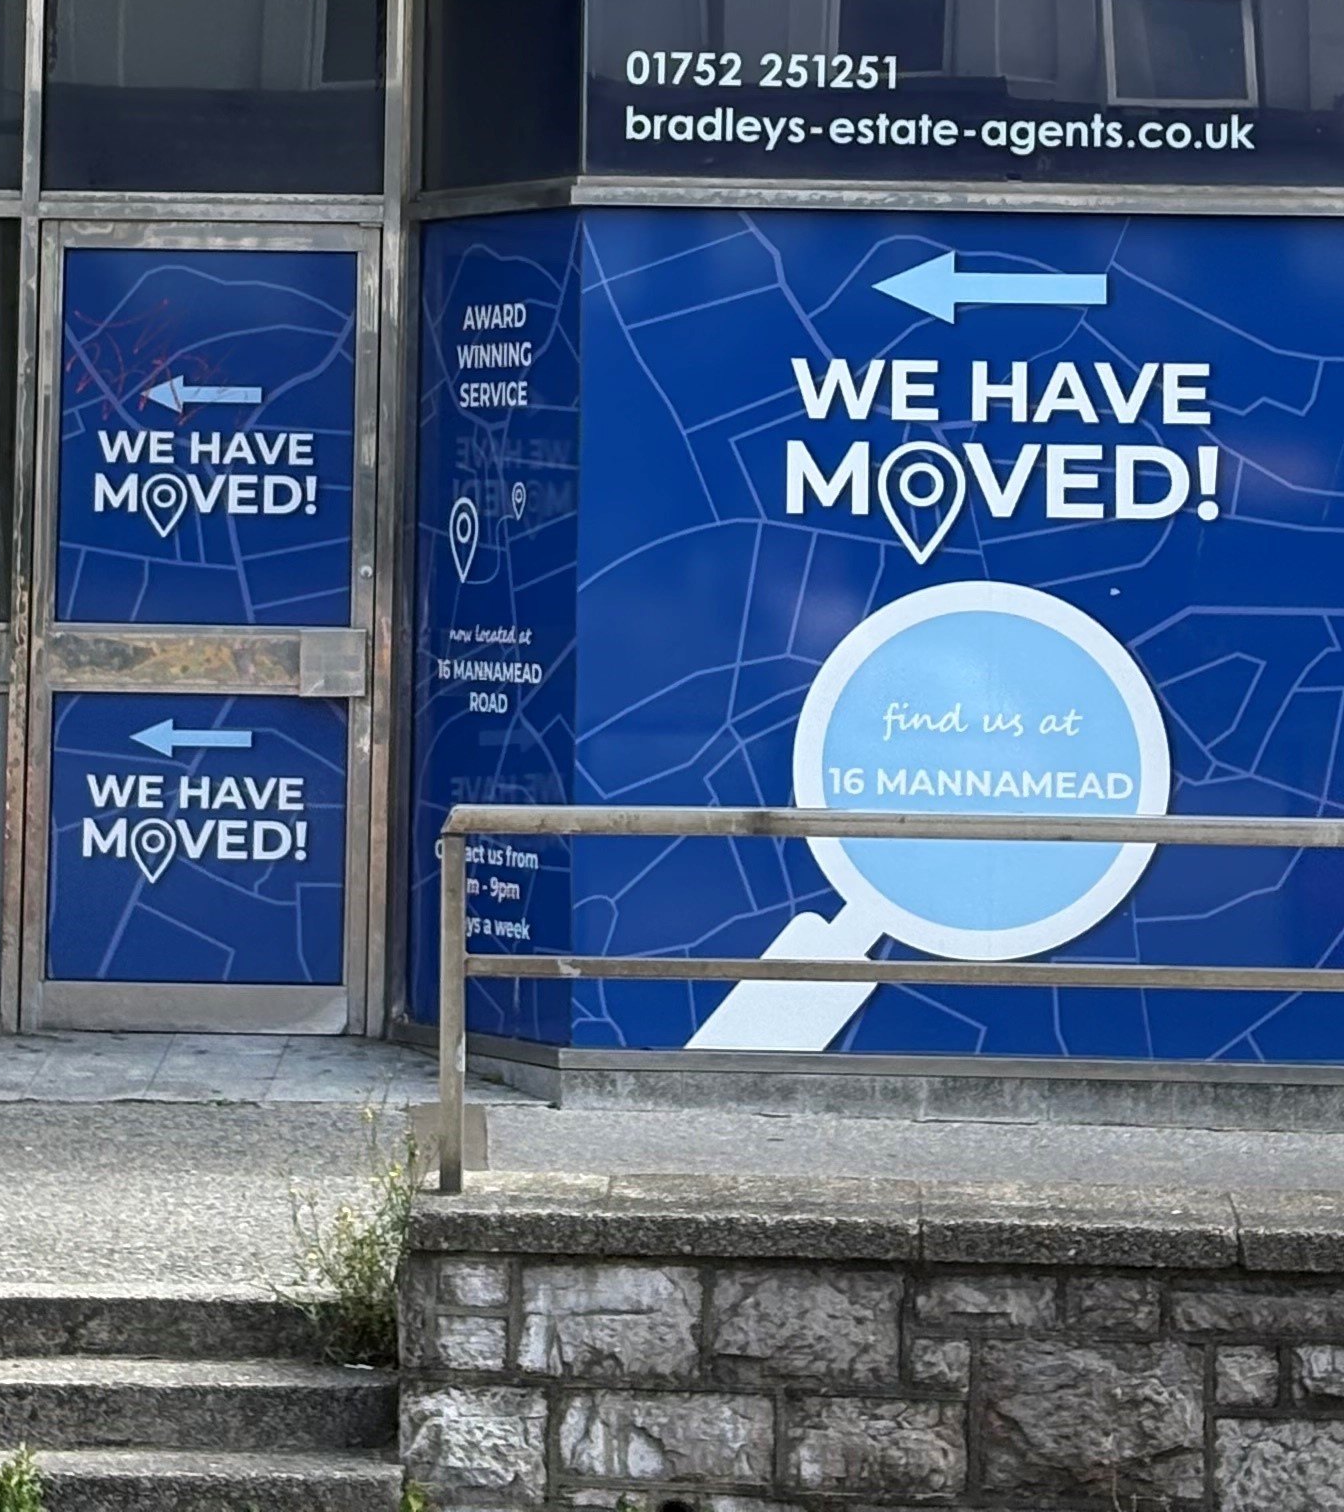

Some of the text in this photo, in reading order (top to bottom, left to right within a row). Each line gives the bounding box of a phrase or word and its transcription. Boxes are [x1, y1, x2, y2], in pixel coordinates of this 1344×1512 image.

[626, 51, 898, 90] 01752 251251
[626, 106, 1255, 155] bradleys-estate-agents.co.uk
[462, 303, 527, 330] AWARD
[457, 342, 532, 369] WINNING
[459, 381, 528, 408] SERVICE
[791, 357, 1210, 425] WE HAVE
[98, 431, 314, 466] WE HAVE
[94, 472, 317, 538] MOVED!
[787, 440, 1218, 565] MOVED!
[475, 624, 516, 643] located
[437, 659, 542, 684] 16 MANNAMEAD
[469, 691, 508, 714] ROAD
[882, 703, 1083, 740] find us at
[87, 774, 304, 811] WE HAVE
[829, 767, 1133, 799] 16 MANNAMEAD
[82, 817, 307, 884] MOVED!
[435, 838, 538, 870] Cact us from
[490, 877, 520, 902] 9pm
[466, 916, 531, 940] ys a week
